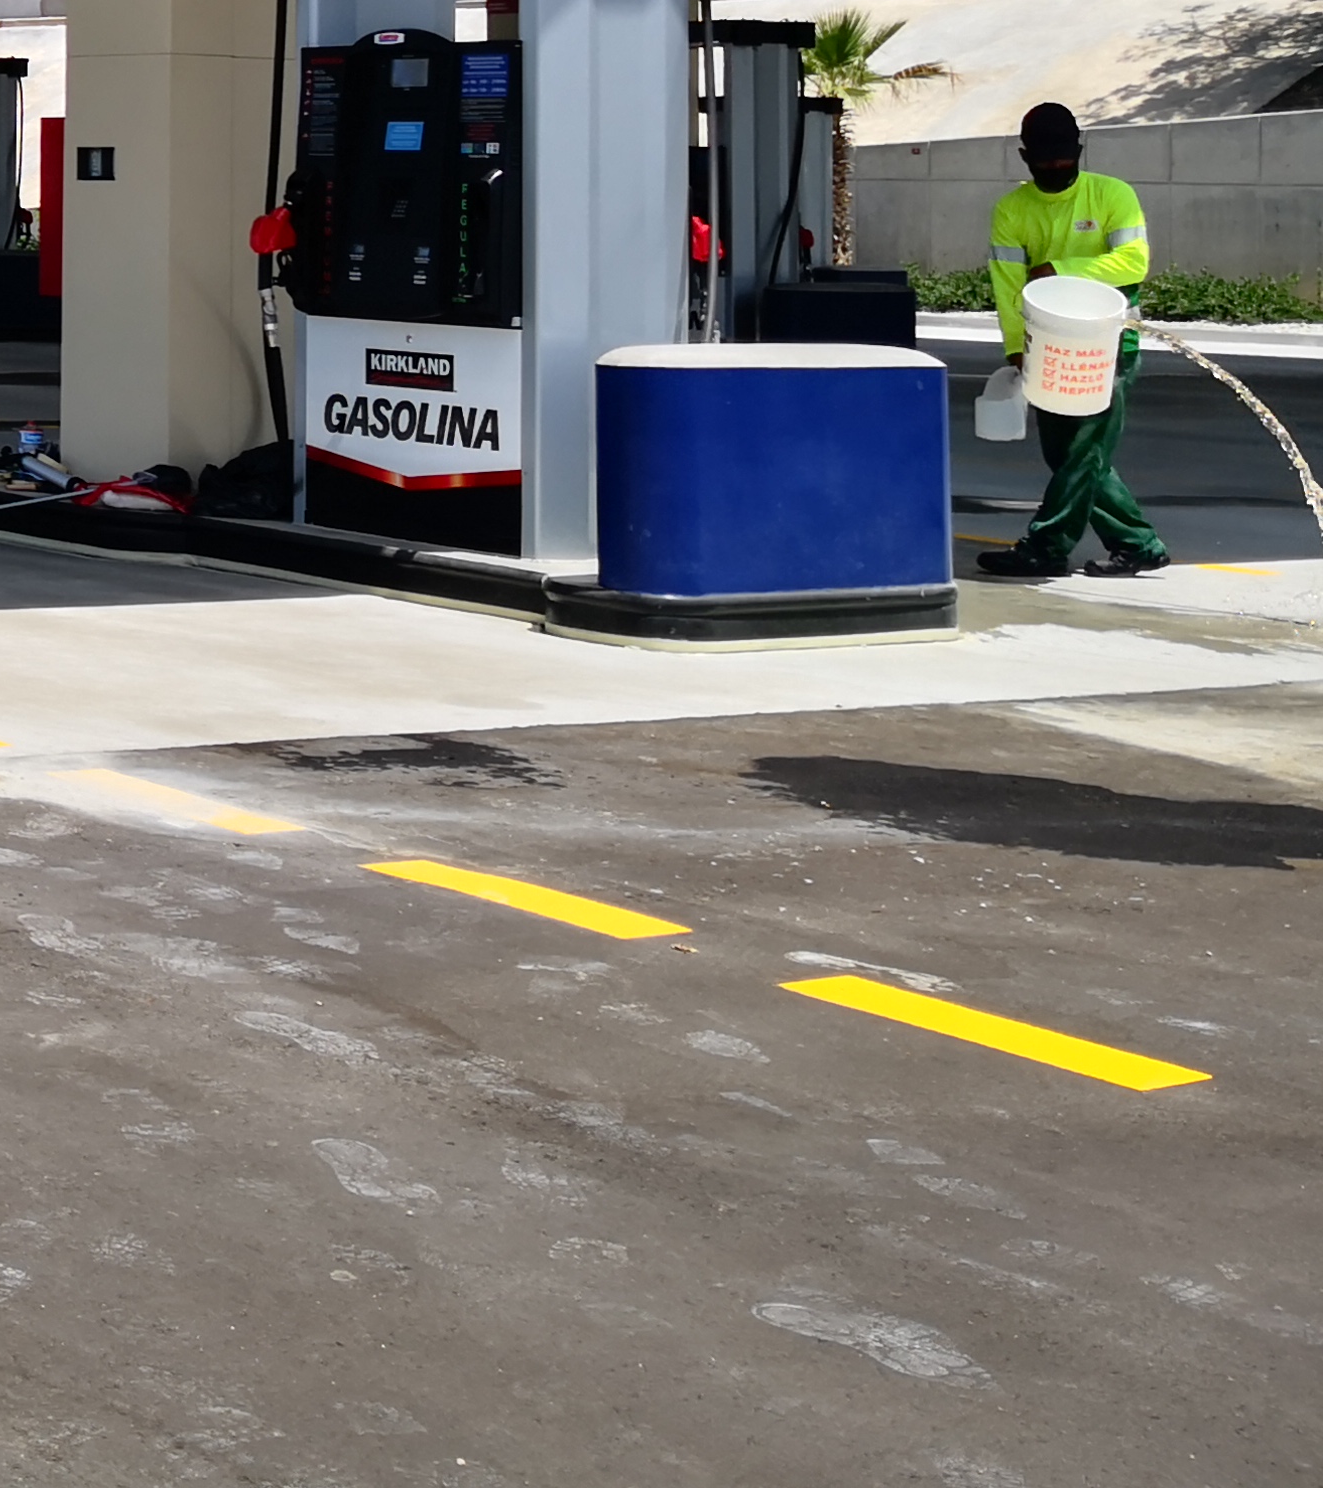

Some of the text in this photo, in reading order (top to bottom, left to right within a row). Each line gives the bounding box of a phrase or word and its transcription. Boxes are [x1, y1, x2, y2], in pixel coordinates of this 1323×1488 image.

[459, 183, 468, 284] REGULA
[370, 352, 451, 376] KIRKLAND
[1044, 344, 1071, 357] HAZ
[324, 393, 500, 452] GASOLINA
